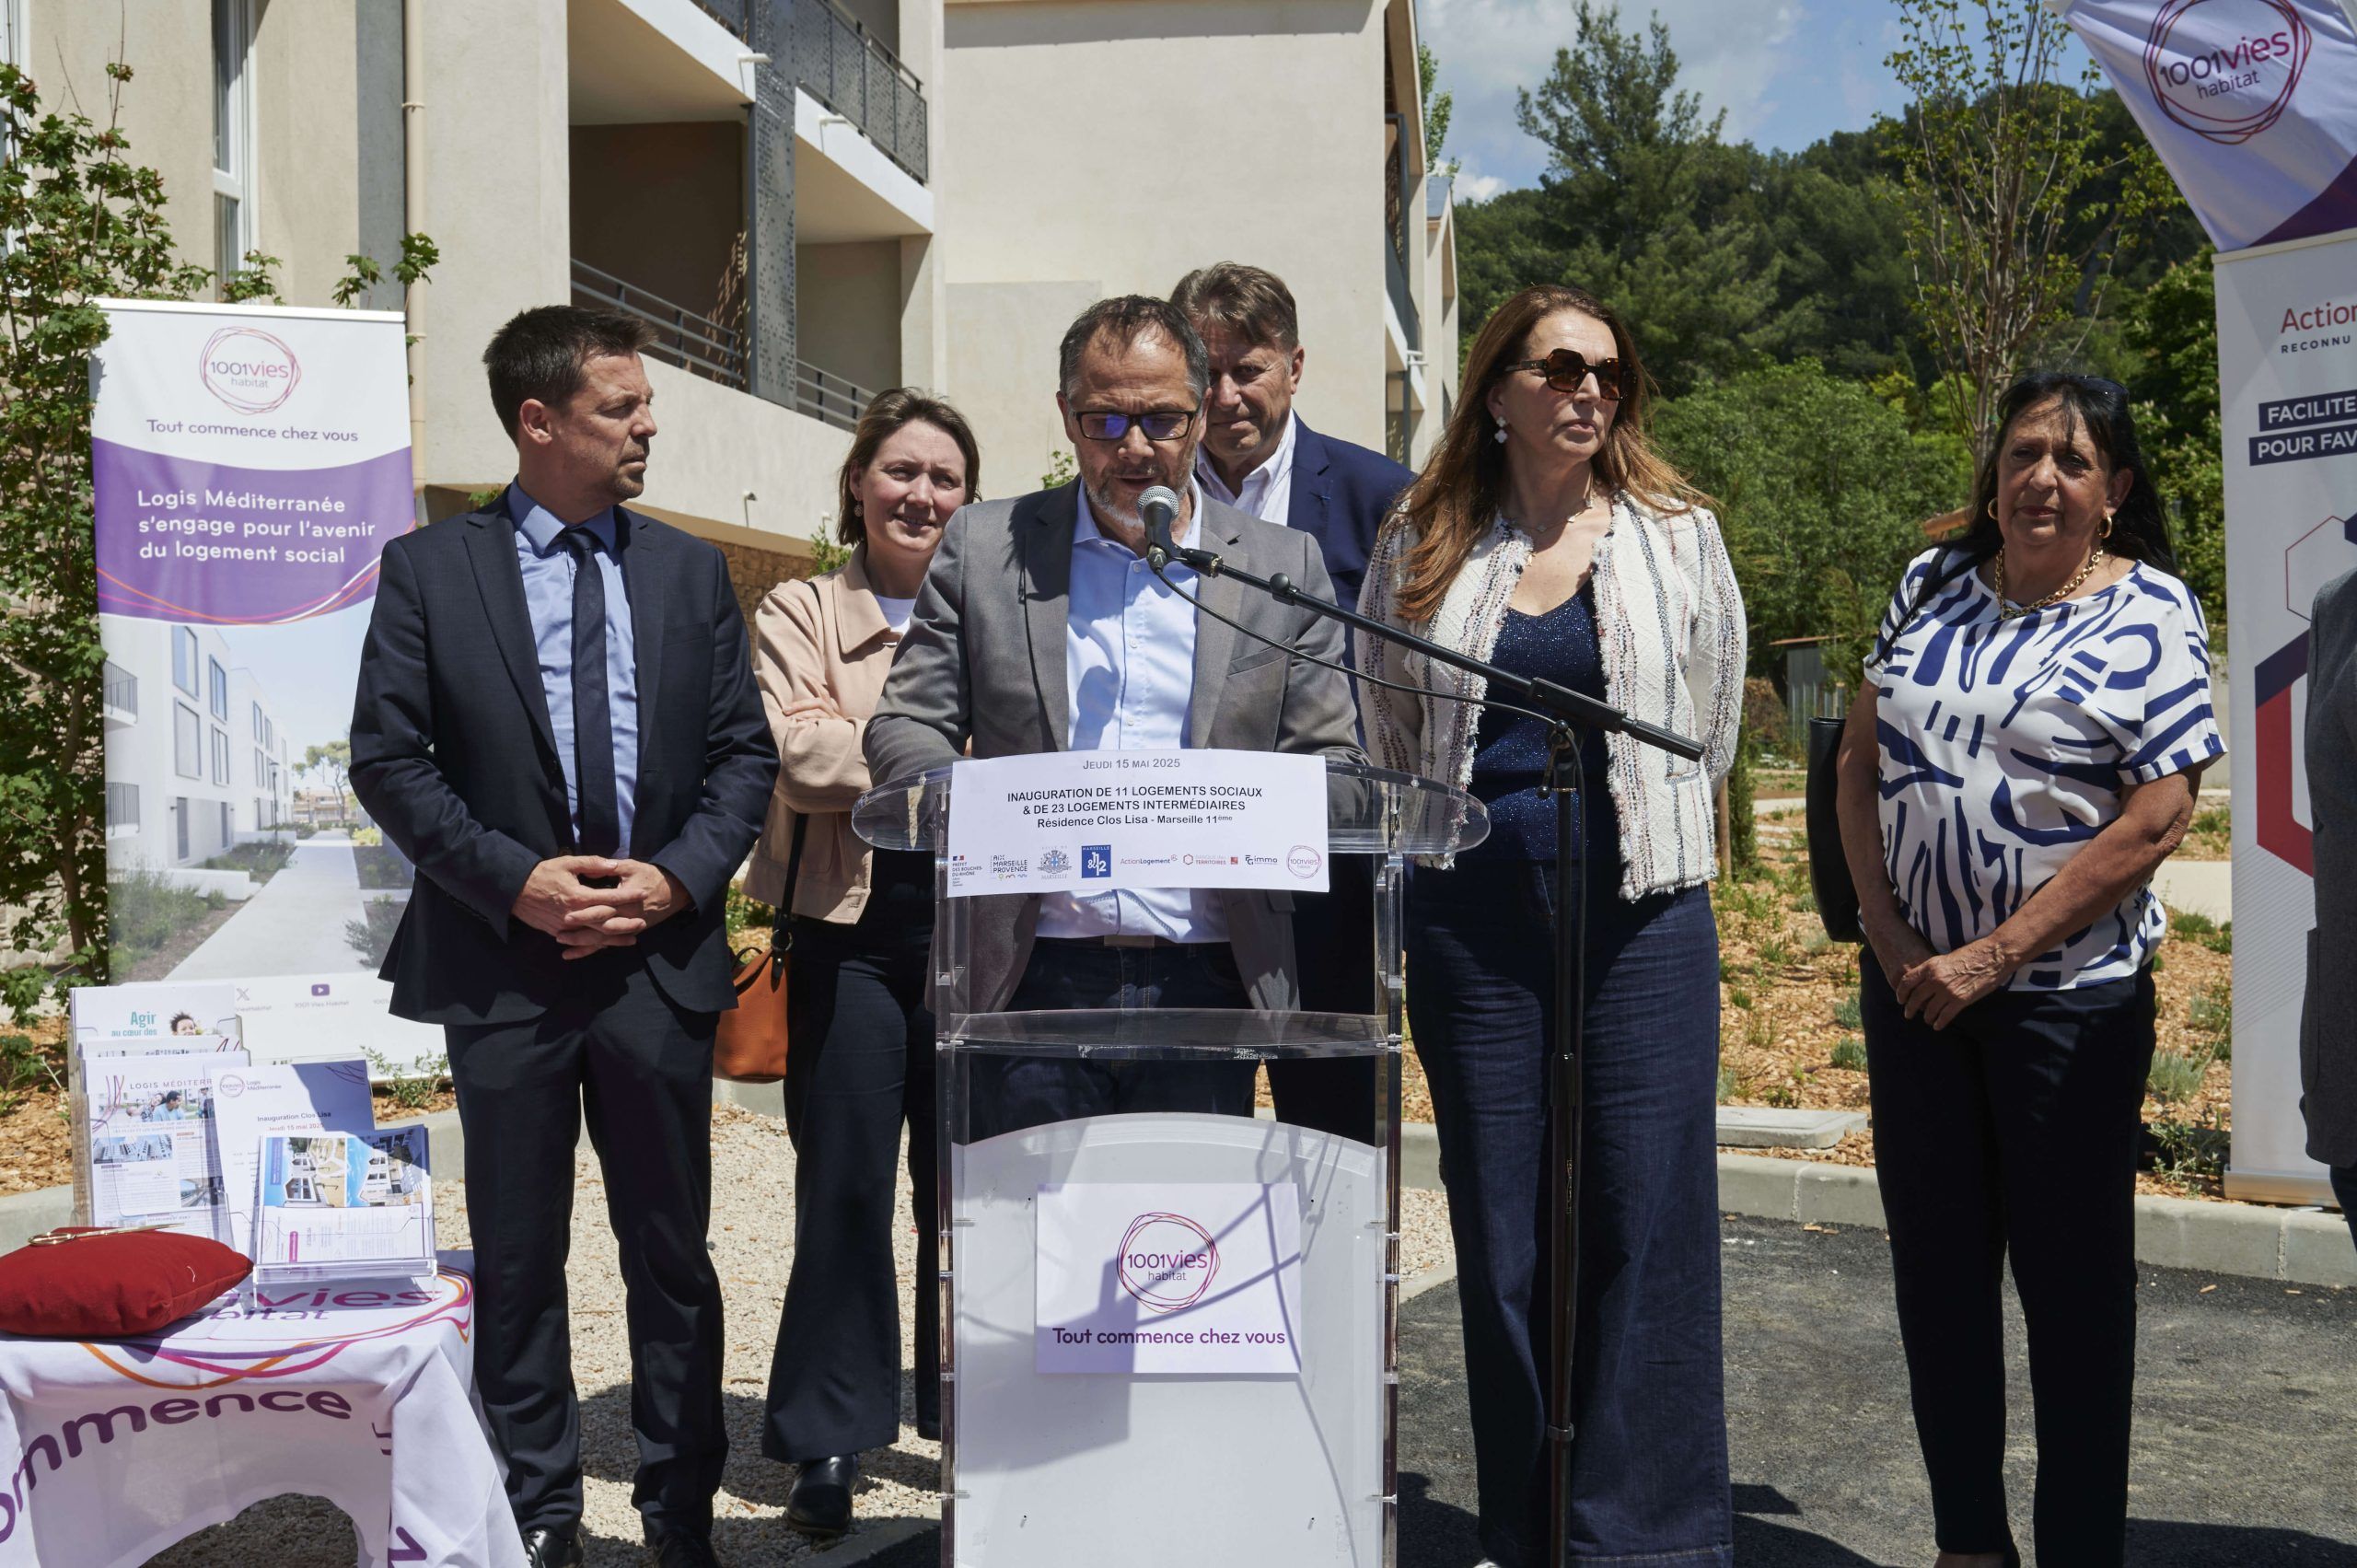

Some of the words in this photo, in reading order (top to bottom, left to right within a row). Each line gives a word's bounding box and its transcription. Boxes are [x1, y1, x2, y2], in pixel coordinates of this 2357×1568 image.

[2159, 31, 2290, 88] 1001vies
[2196, 70, 2260, 99] habitat
[2281, 335, 2351, 354] RECONNU
[210, 360, 289, 378] 1001vies
[230, 377, 269, 389] habitat
[2268, 396, 2357, 424] FACILITE
[145, 418, 183, 433] Tout
[188, 424, 276, 439] commence
[281, 426, 319, 440] chez
[322, 431, 359, 442] vous
[2258, 436, 2315, 459] POUR
[137, 490, 197, 510] Logis
[205, 490, 346, 513] Méditerranée
[138, 516, 236, 536] s'engage
[243, 521, 292, 538] pour
[299, 519, 376, 538] l'avenir
[139, 541, 167, 559] du
[175, 540, 277, 562] logement
[284, 547, 345, 563] social
[1083, 760, 1112, 770] JEUDI
[1116, 759, 1129, 769] 15
[1153, 758, 1180, 768] 2025
[1007, 787, 1093, 802] INAUGURATION
[1096, 787, 1112, 797] DE
[1115, 786, 1128, 796] 11
[1132, 785, 1206, 796] LOGEMENTS
[1210, 786, 1262, 797] SOCIAUX
[1023, 806, 1030, 815] &
[1034, 805, 1049, 814] DE
[1051, 804, 1064, 813] 23
[1067, 800, 1140, 812] LOGEMENTS
[1143, 798, 1246, 810] INTERMÉDIAIRES
[1038, 817, 1094, 828] Résidence
[1097, 815, 1121, 825] Clos
[1125, 815, 1148, 824] Lisa
[1156, 815, 1202, 824] Marseille
[993, 865, 1028, 874] PROVENCE
[130, 1011, 157, 1028] Agir
[144, 1028, 157, 1036] des
[162, 1078, 213, 1087] MÉDITERR
[257, 1113, 299, 1121] Inauguration
[1127, 1249, 1208, 1269] 1001vies
[1147, 1271, 1187, 1281] habitat
[1052, 1328, 1092, 1343] Tout
[1097, 1331, 1194, 1344] commence
[1199, 1328, 1240, 1343] chez
[1245, 1332, 1285, 1344] vous
